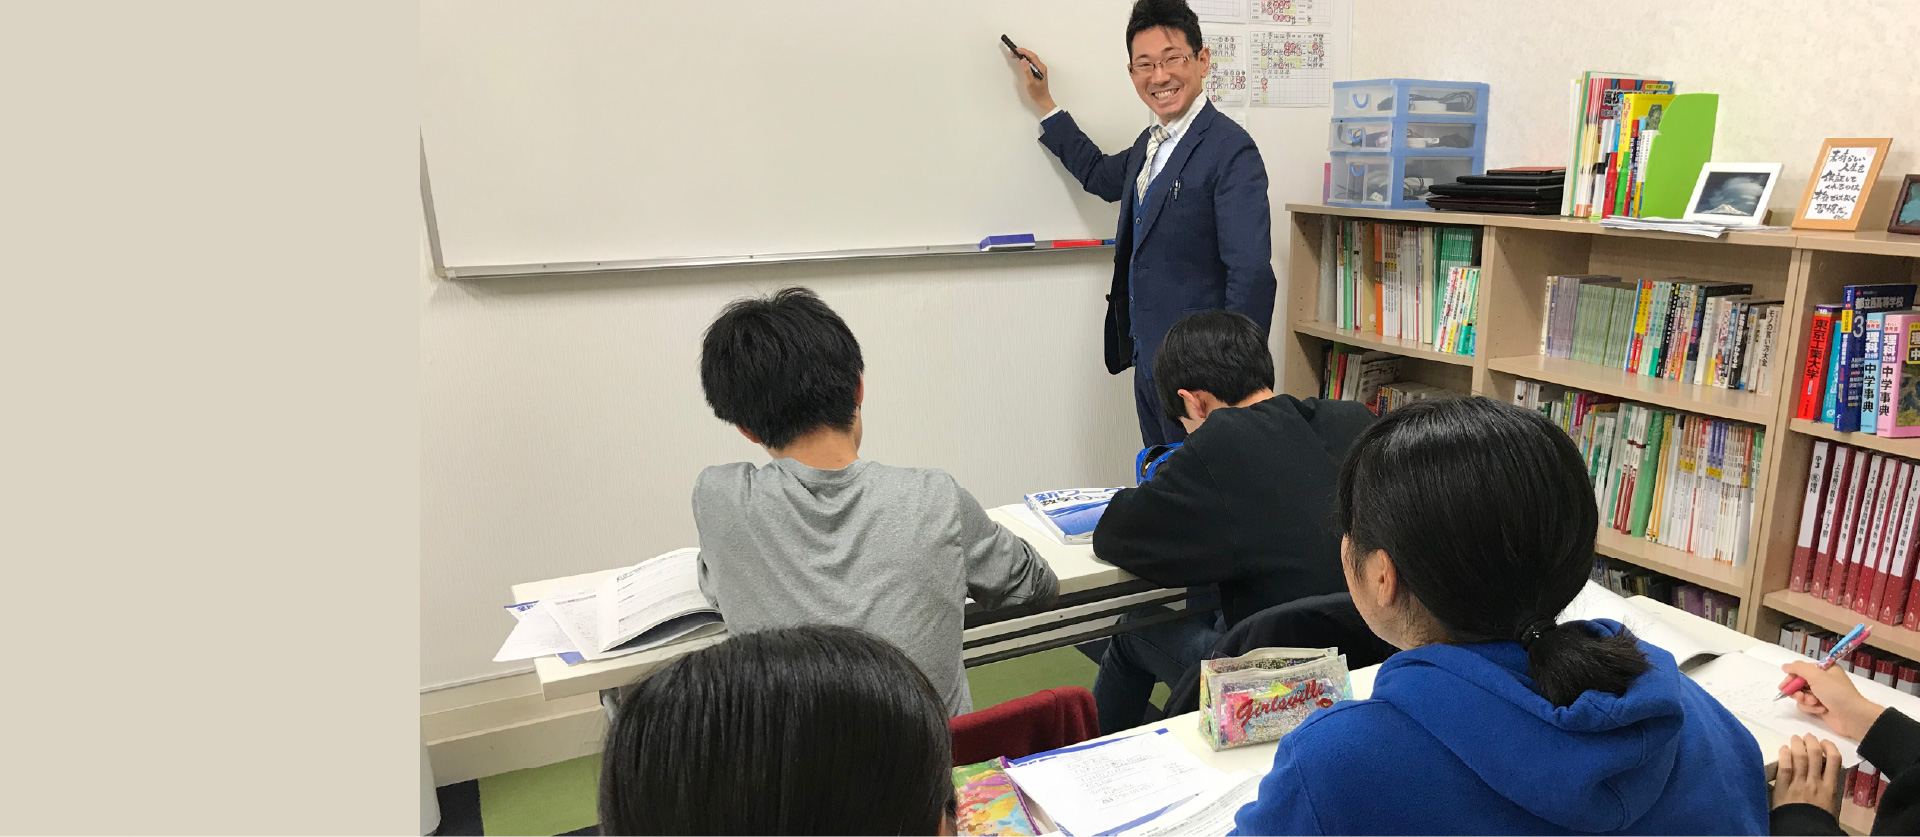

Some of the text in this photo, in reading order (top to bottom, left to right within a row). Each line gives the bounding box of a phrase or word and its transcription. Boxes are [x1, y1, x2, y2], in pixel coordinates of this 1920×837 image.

[1829, 149, 1865, 163] 素晴らしい
[1838, 162, 1865, 173] 人生を
[1806, 319, 1828, 379] 東京工業大学
[1864, 331, 1880, 353] 理科
[1883, 334, 1897, 356] 理科
[1862, 362, 1877, 413] 中学事典
[1879, 366, 1894, 417] 中学事典
